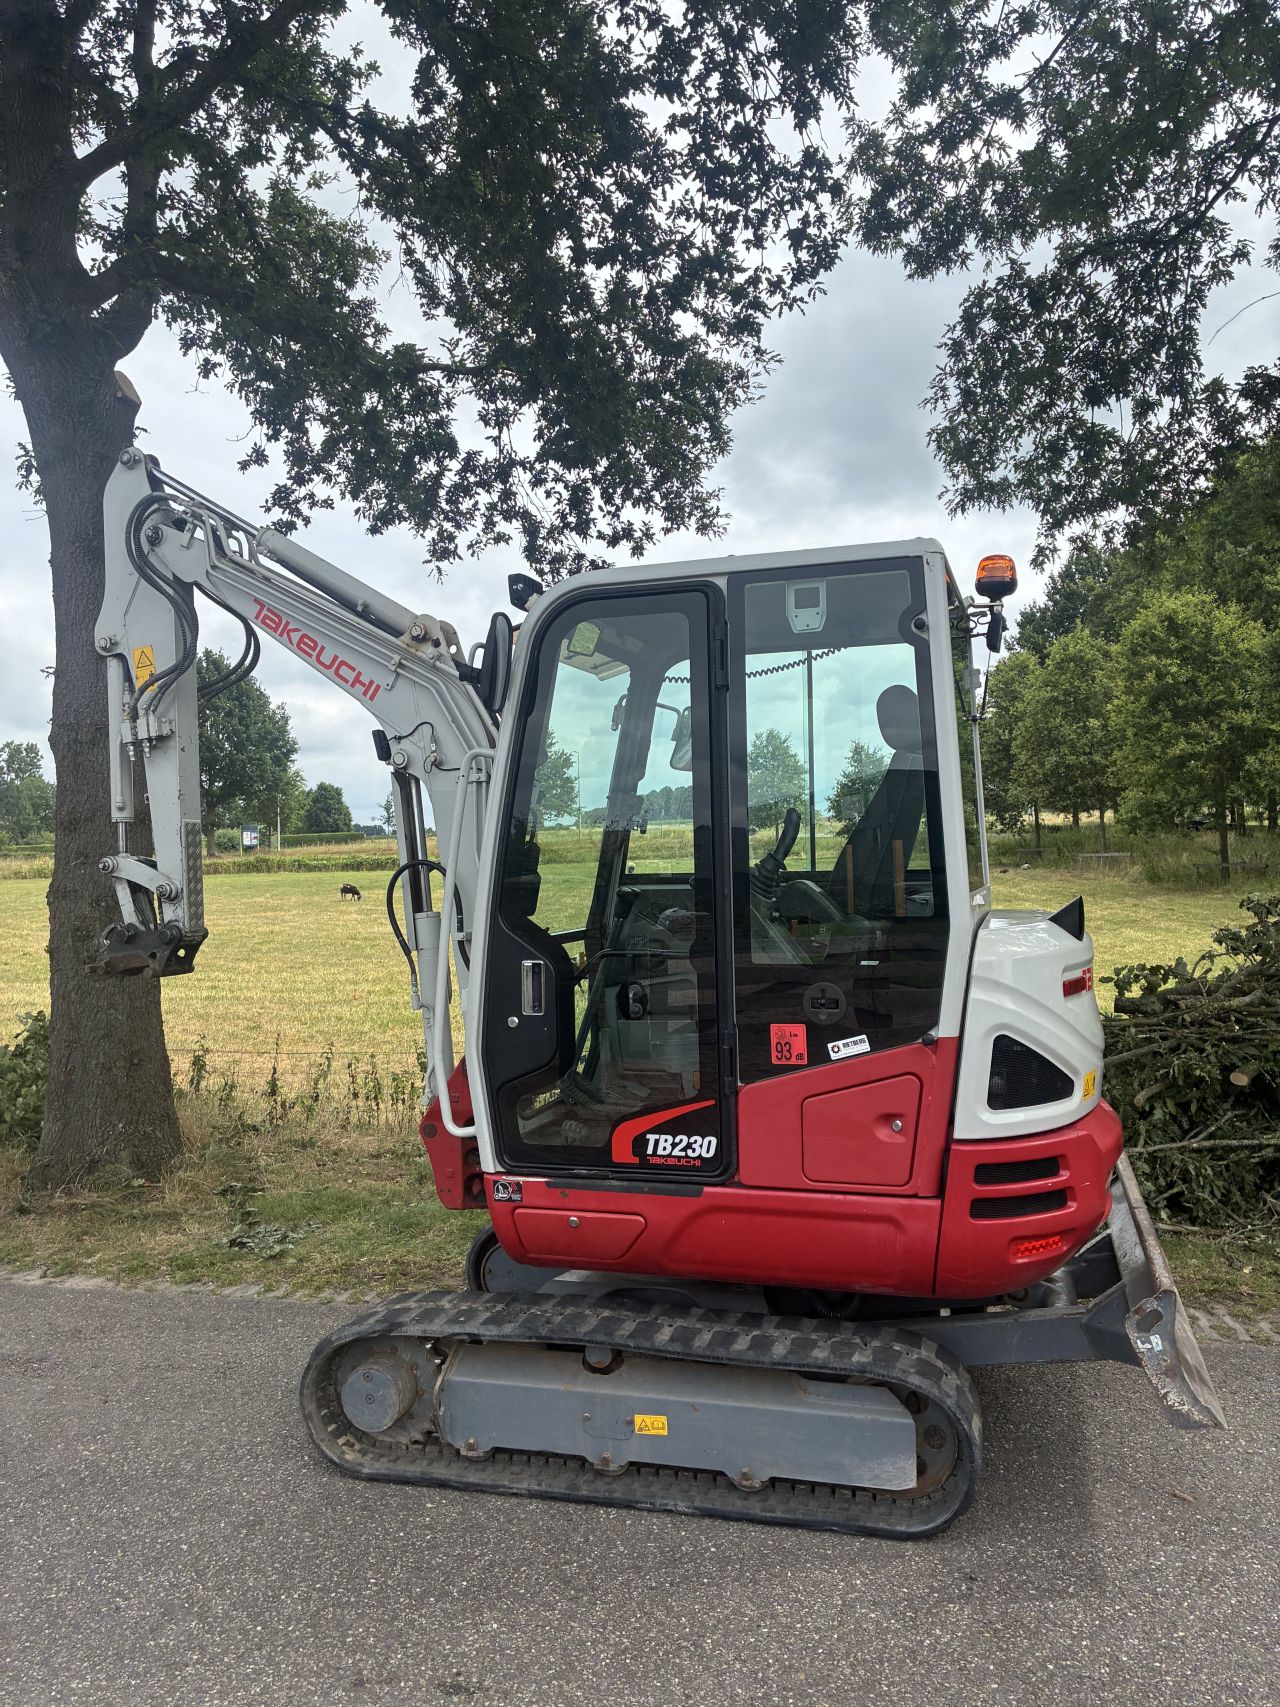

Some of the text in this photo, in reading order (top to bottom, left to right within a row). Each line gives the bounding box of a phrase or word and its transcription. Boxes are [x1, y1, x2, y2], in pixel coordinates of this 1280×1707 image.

[253, 597, 381, 702] TAKEUCHI
[776, 1041, 804, 1060] 93 dB
[646, 1134, 717, 1158] TB230
[647, 1156, 701, 1166] TAKEUCHI
